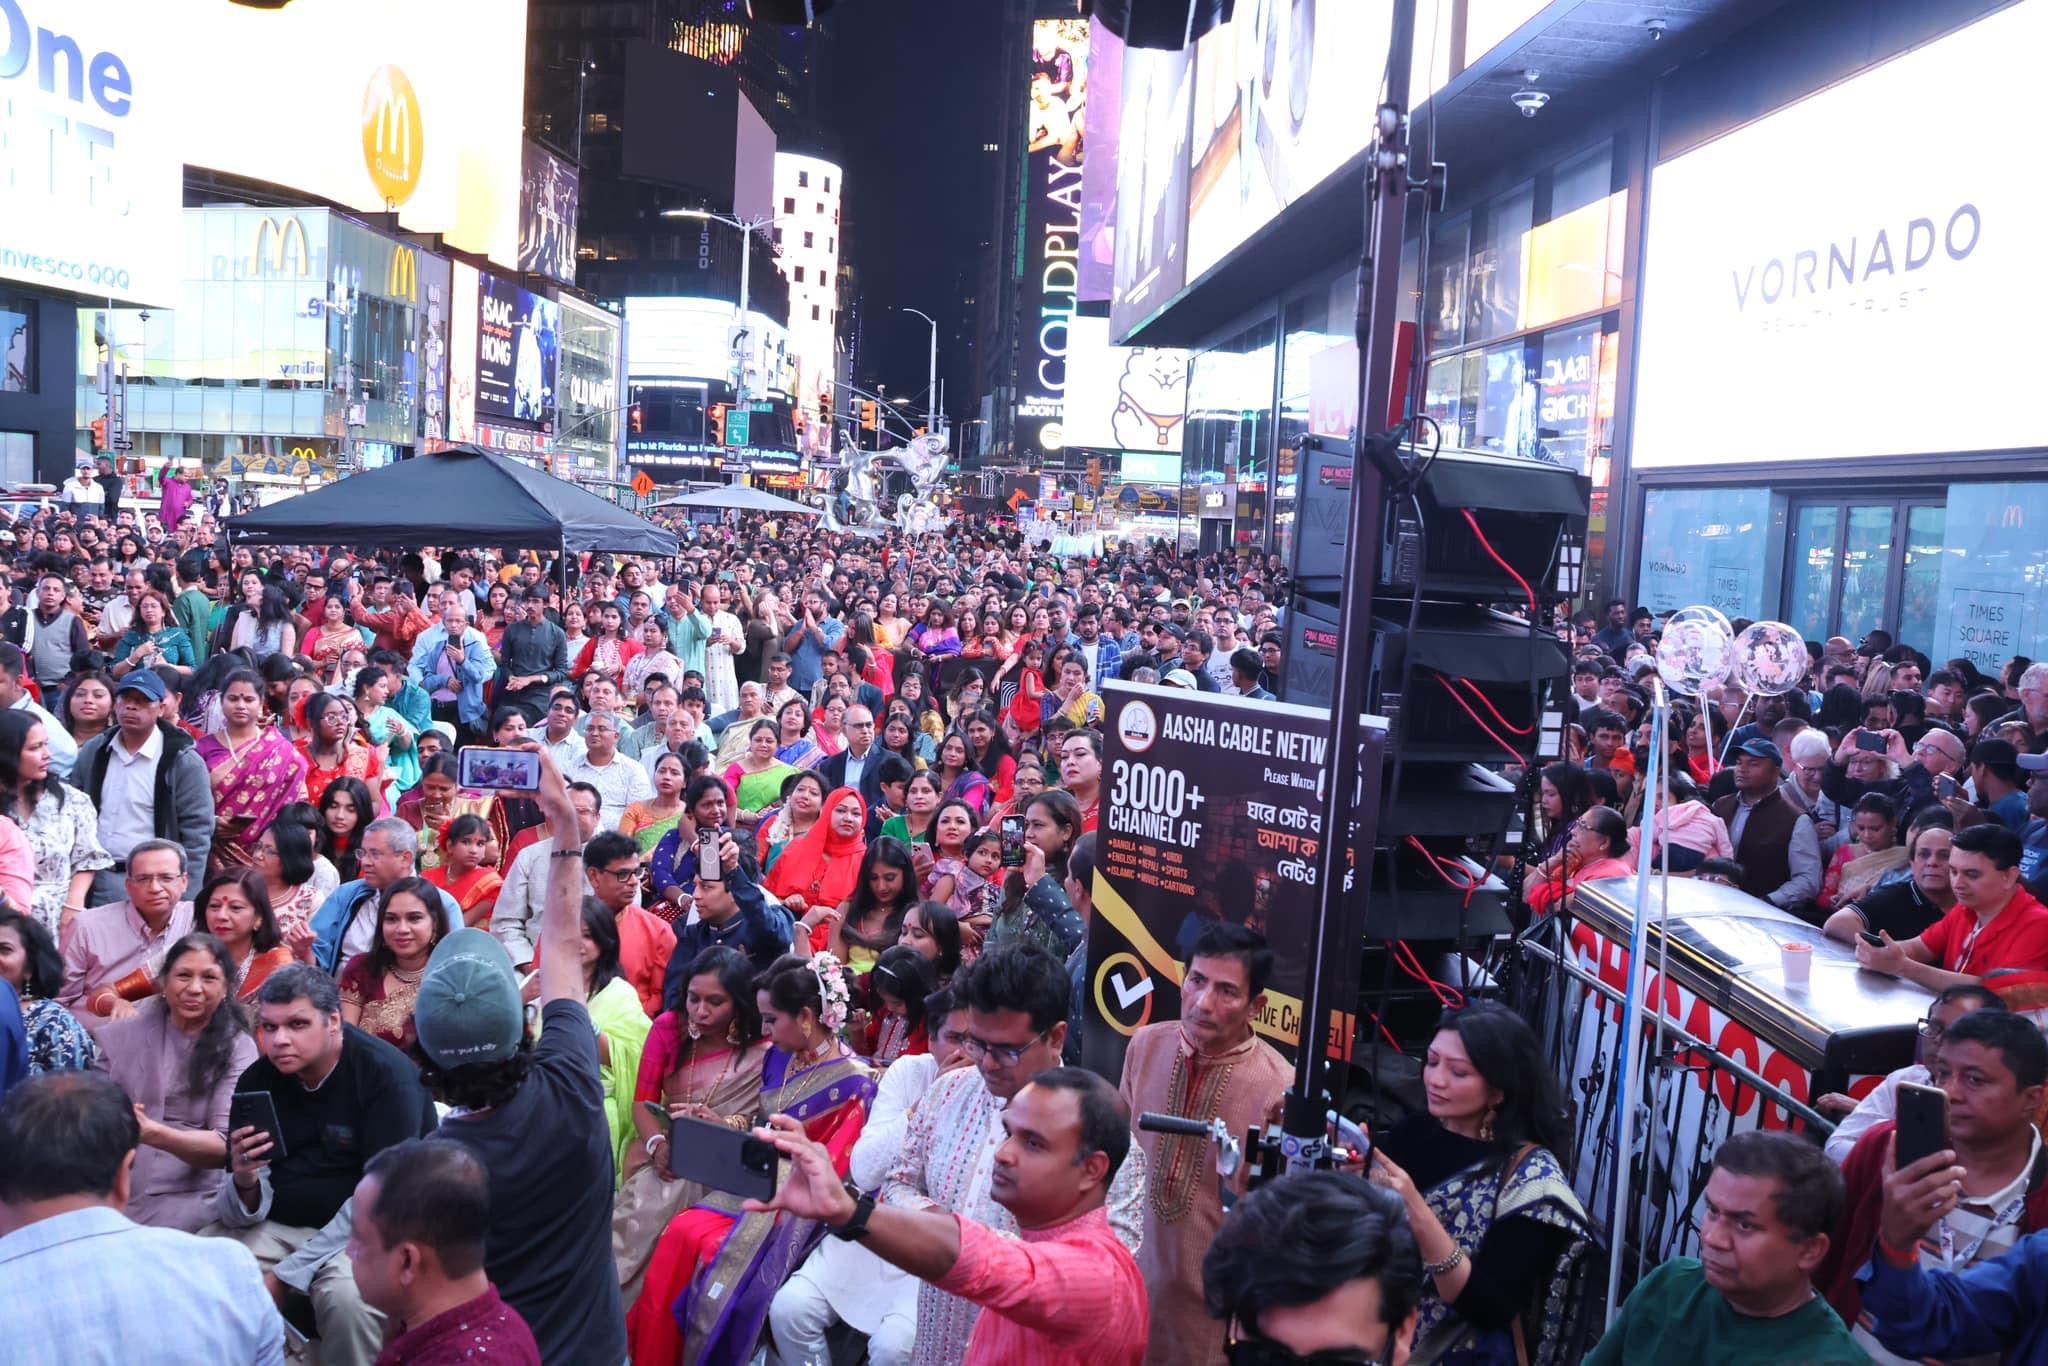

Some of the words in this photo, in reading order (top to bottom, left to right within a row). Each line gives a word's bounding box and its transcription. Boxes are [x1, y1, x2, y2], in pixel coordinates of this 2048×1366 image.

[0, 246, 84, 281] nvesco
[88, 263, 130, 290] QQQ
[1733, 203, 1980, 312] VORNADO
[1037, 157, 1083, 391] COLDPLAY
[483, 295, 513, 329] ISAAC
[481, 334, 512, 367] HONG
[570, 374, 588, 405] OLD
[1649, 561, 1687, 574] VORNADO
[1718, 578, 1738, 591] TIMES
[1711, 595, 1741, 610] SQUARE
[1969, 604, 2004, 622] TIMES
[1959, 626, 2010, 646] SQUARE
[1964, 649, 2001, 669] PRIME
[1162, 713, 1215, 747] AASHA
[1219, 721, 1273, 757] CABLE
[1110, 759, 1205, 818] 3000+
[1108, 805, 1176, 844] CHANNEL
[1180, 820, 1202, 849] OF
[1247, 801, 1277, 825] ঘরে
[1279, 806, 1308, 830] সেট
[1112, 838, 1136, 851] BANGLA
[1258, 828, 1298, 854] আশা
[1111, 851, 1137, 865] ENGLISH
[1165, 865, 1188, 879] SPORTS
[1110, 865, 1135, 879] ISLAMIC
[1164, 880, 1196, 896] CARTOONS
